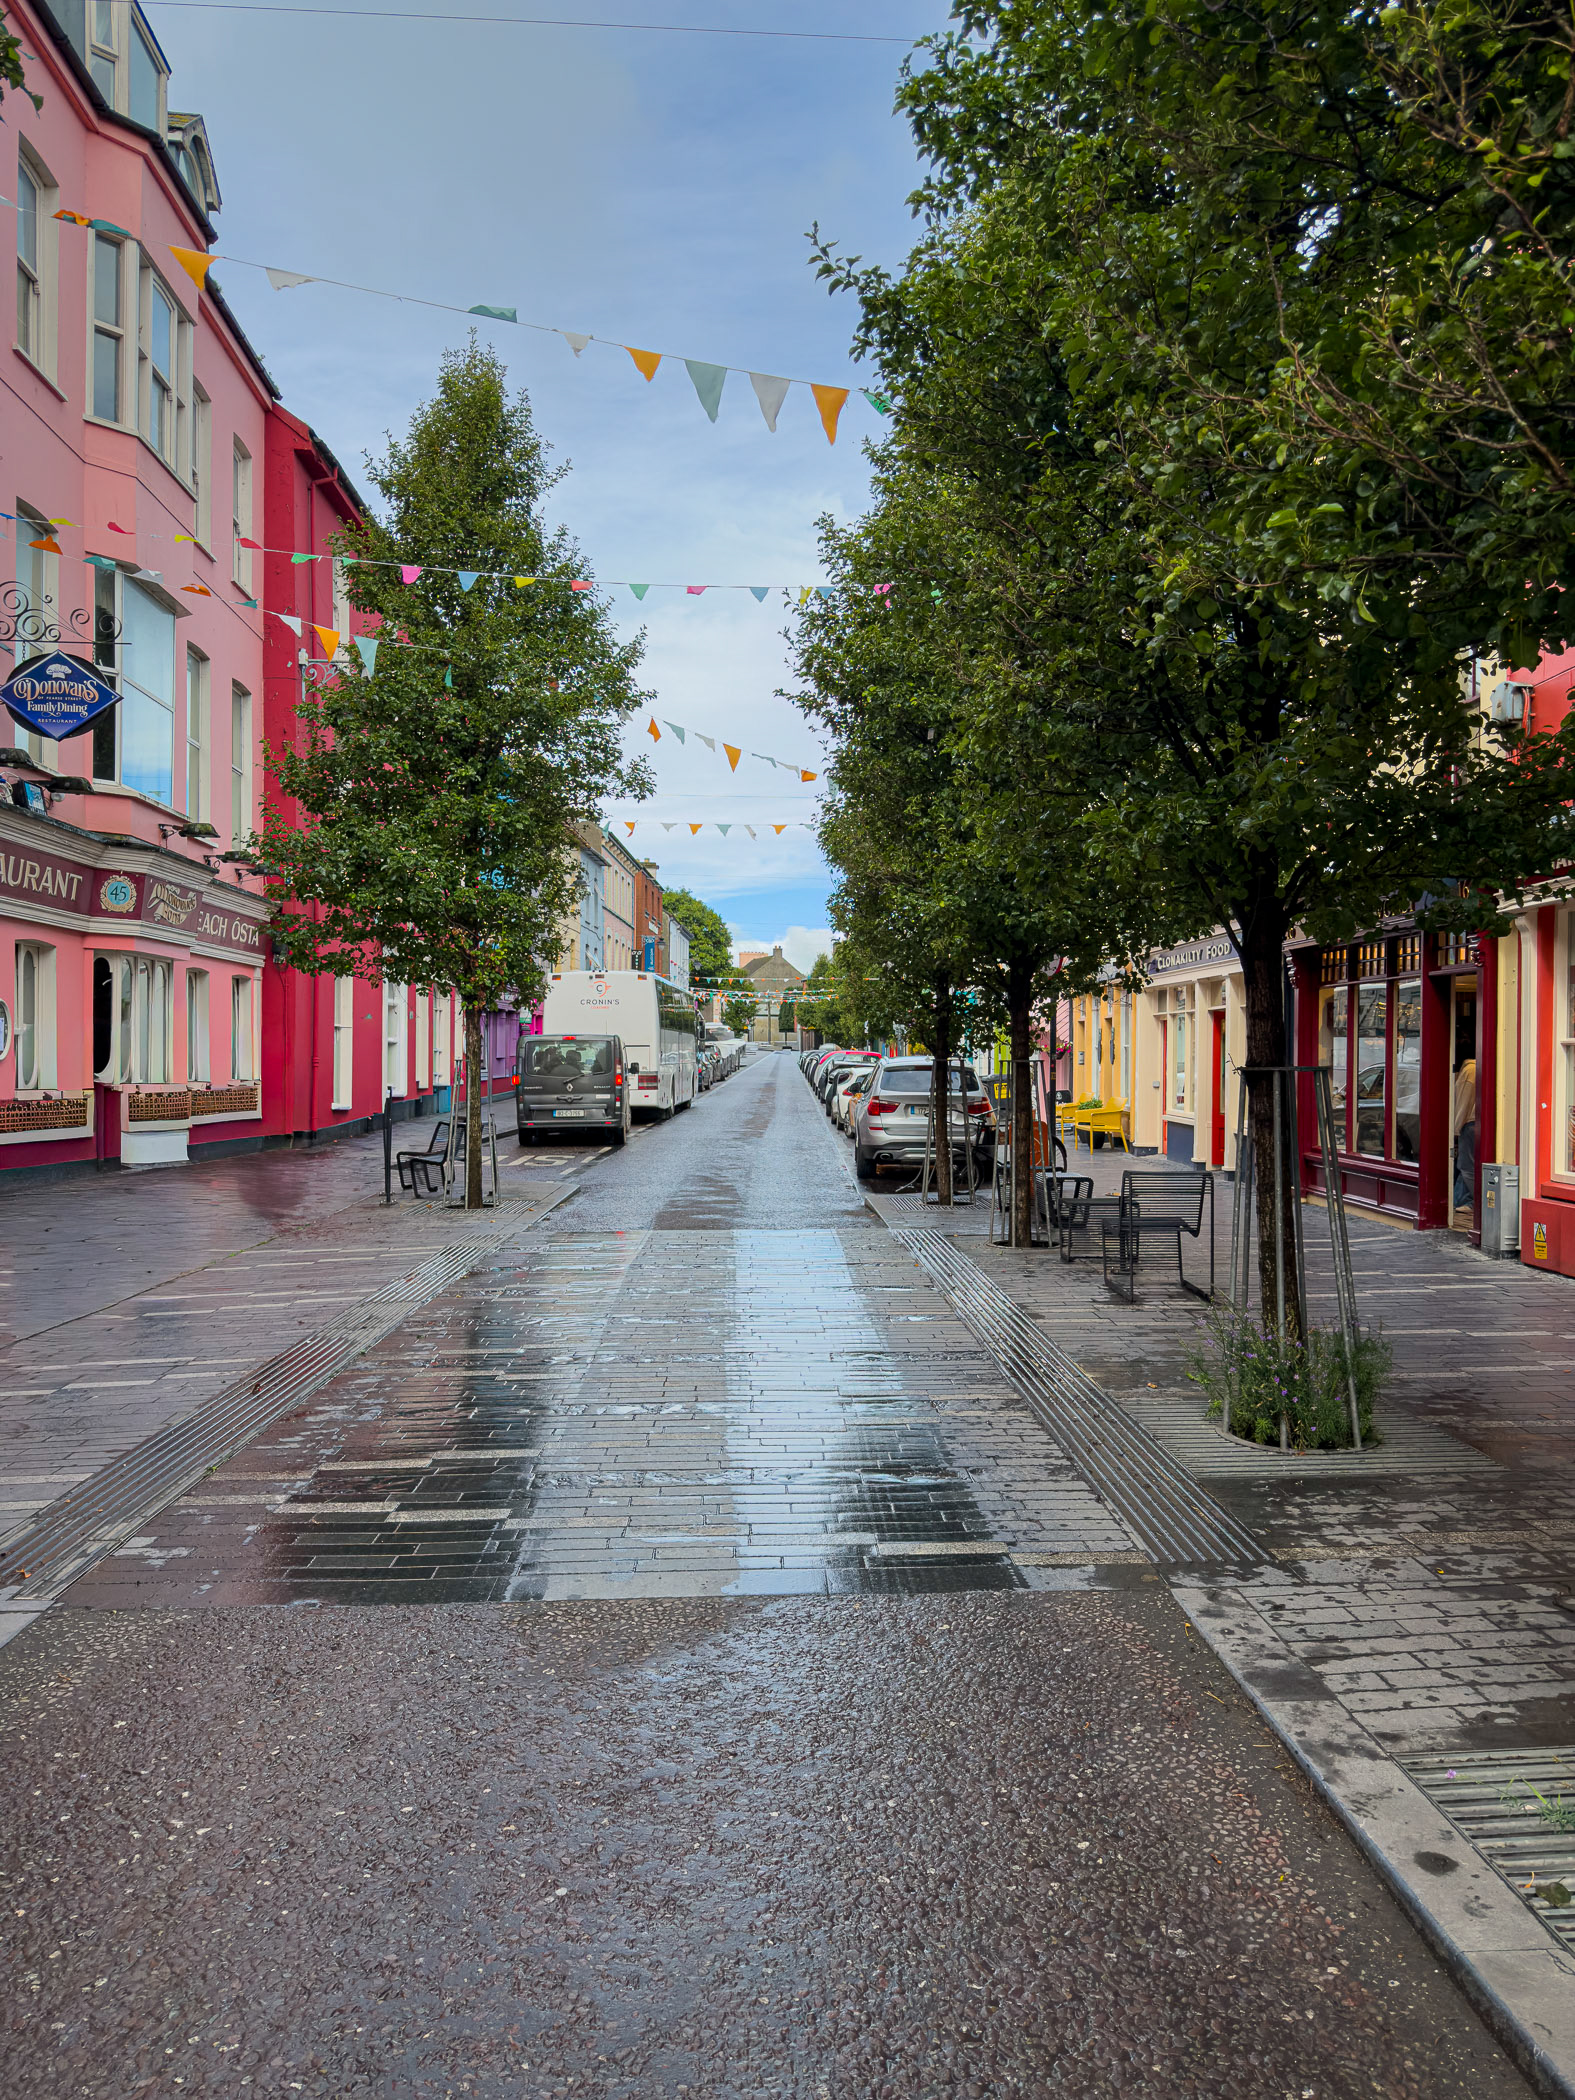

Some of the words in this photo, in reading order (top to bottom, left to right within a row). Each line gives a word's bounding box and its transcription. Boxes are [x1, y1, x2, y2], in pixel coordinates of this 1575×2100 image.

[27, 701, 59, 716] Family
[57, 702, 89, 718] Dining
[110, 885, 127, 902] 45
[1157, 949, 1202, 970] CLONAKILTY
[1206, 943, 1231, 960] FOOD
